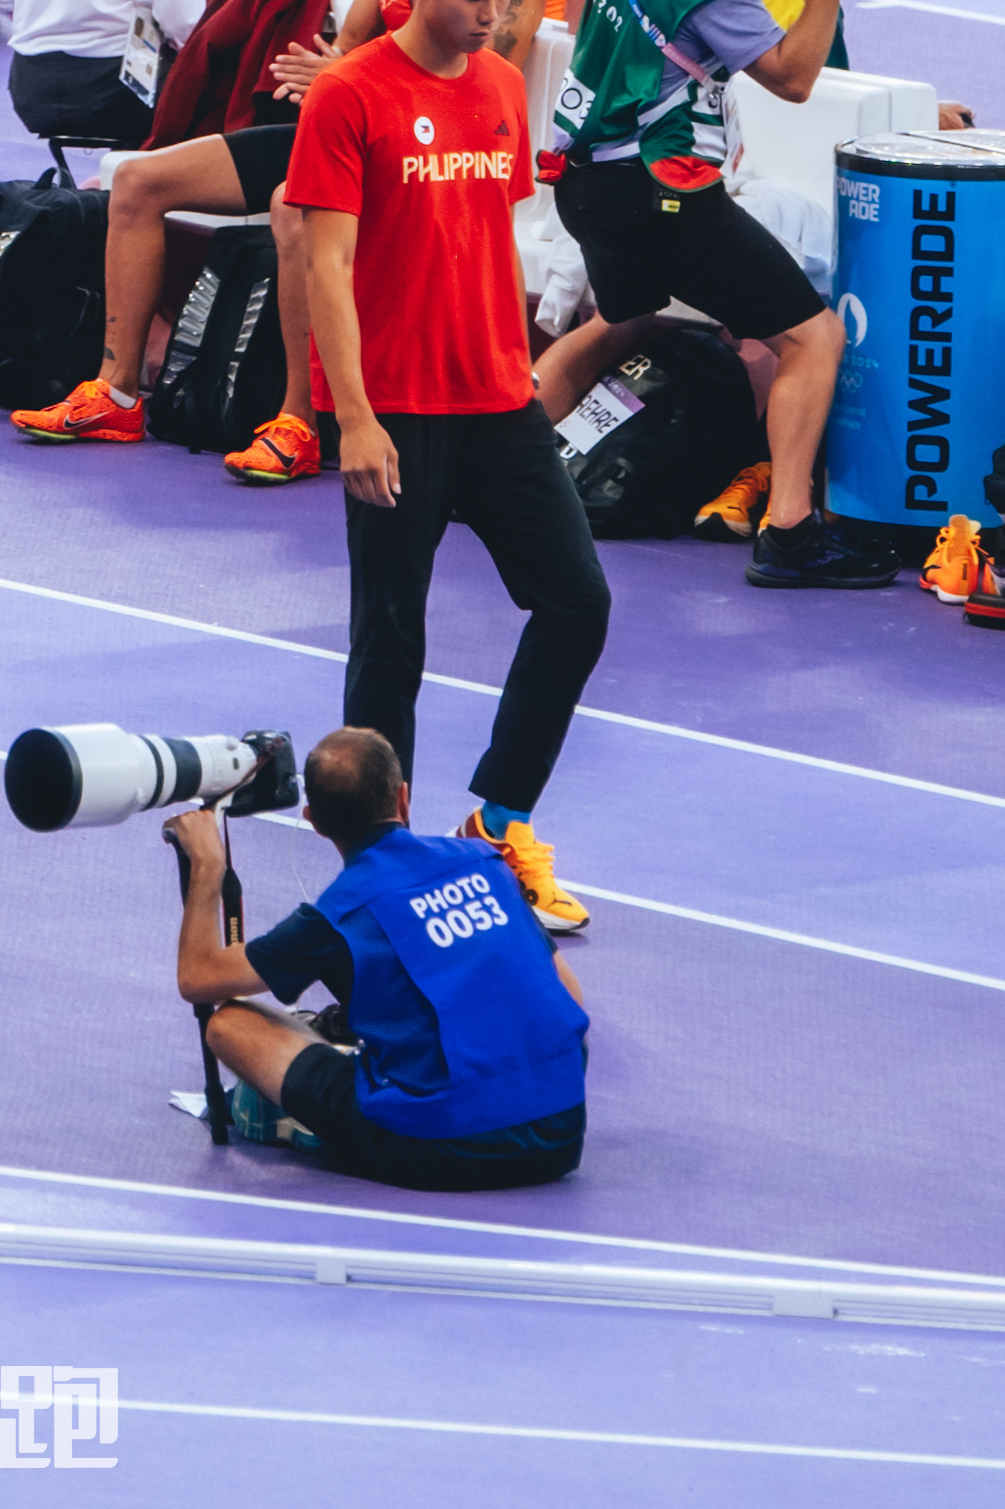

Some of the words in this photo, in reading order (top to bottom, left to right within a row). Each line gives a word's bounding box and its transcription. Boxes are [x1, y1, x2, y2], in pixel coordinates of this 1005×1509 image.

[849, 199, 880, 222] ADE
[904, 189, 957, 513] POWERADE
[409, 872, 491, 919] PHOTO
[426, 895, 509, 948] 0053
